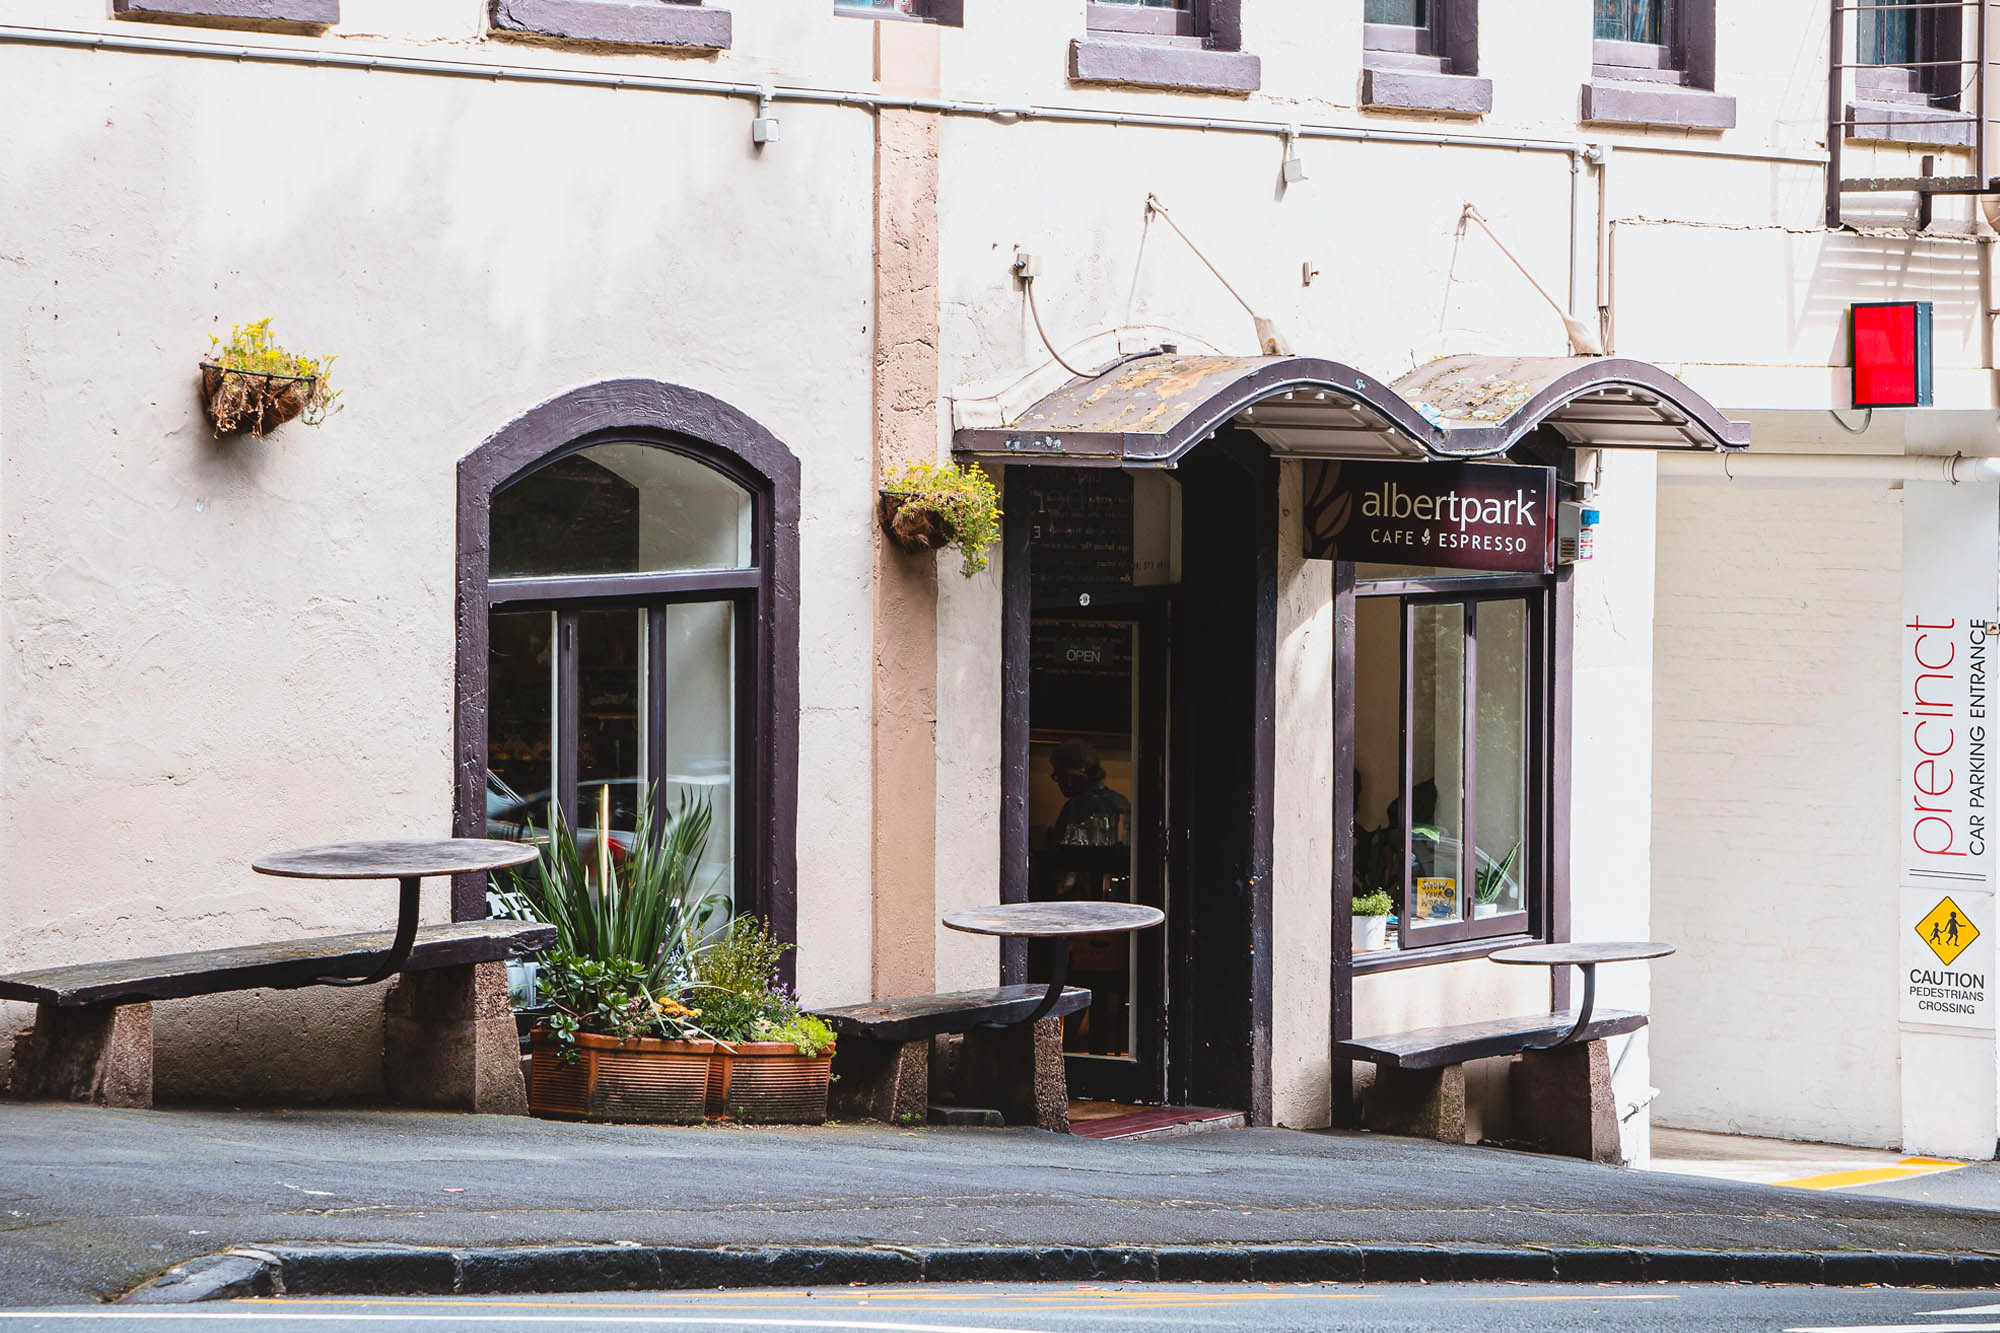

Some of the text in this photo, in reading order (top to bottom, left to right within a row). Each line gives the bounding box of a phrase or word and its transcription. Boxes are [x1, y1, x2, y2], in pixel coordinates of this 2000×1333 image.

[1361, 481, 1537, 532] albertpark
[1371, 528, 1527, 553] CAFE ESPRESSO
[1066, 649, 1101, 663] OPEN
[1902, 615, 1967, 856] precinct
[1969, 619, 1986, 856] CAR PARKING ENTRANCE
[1910, 968, 1985, 989] CAUTION
[1909, 986, 1985, 1002] PEDESTRIANS
[1918, 1000, 1975, 1015] CROSSING
